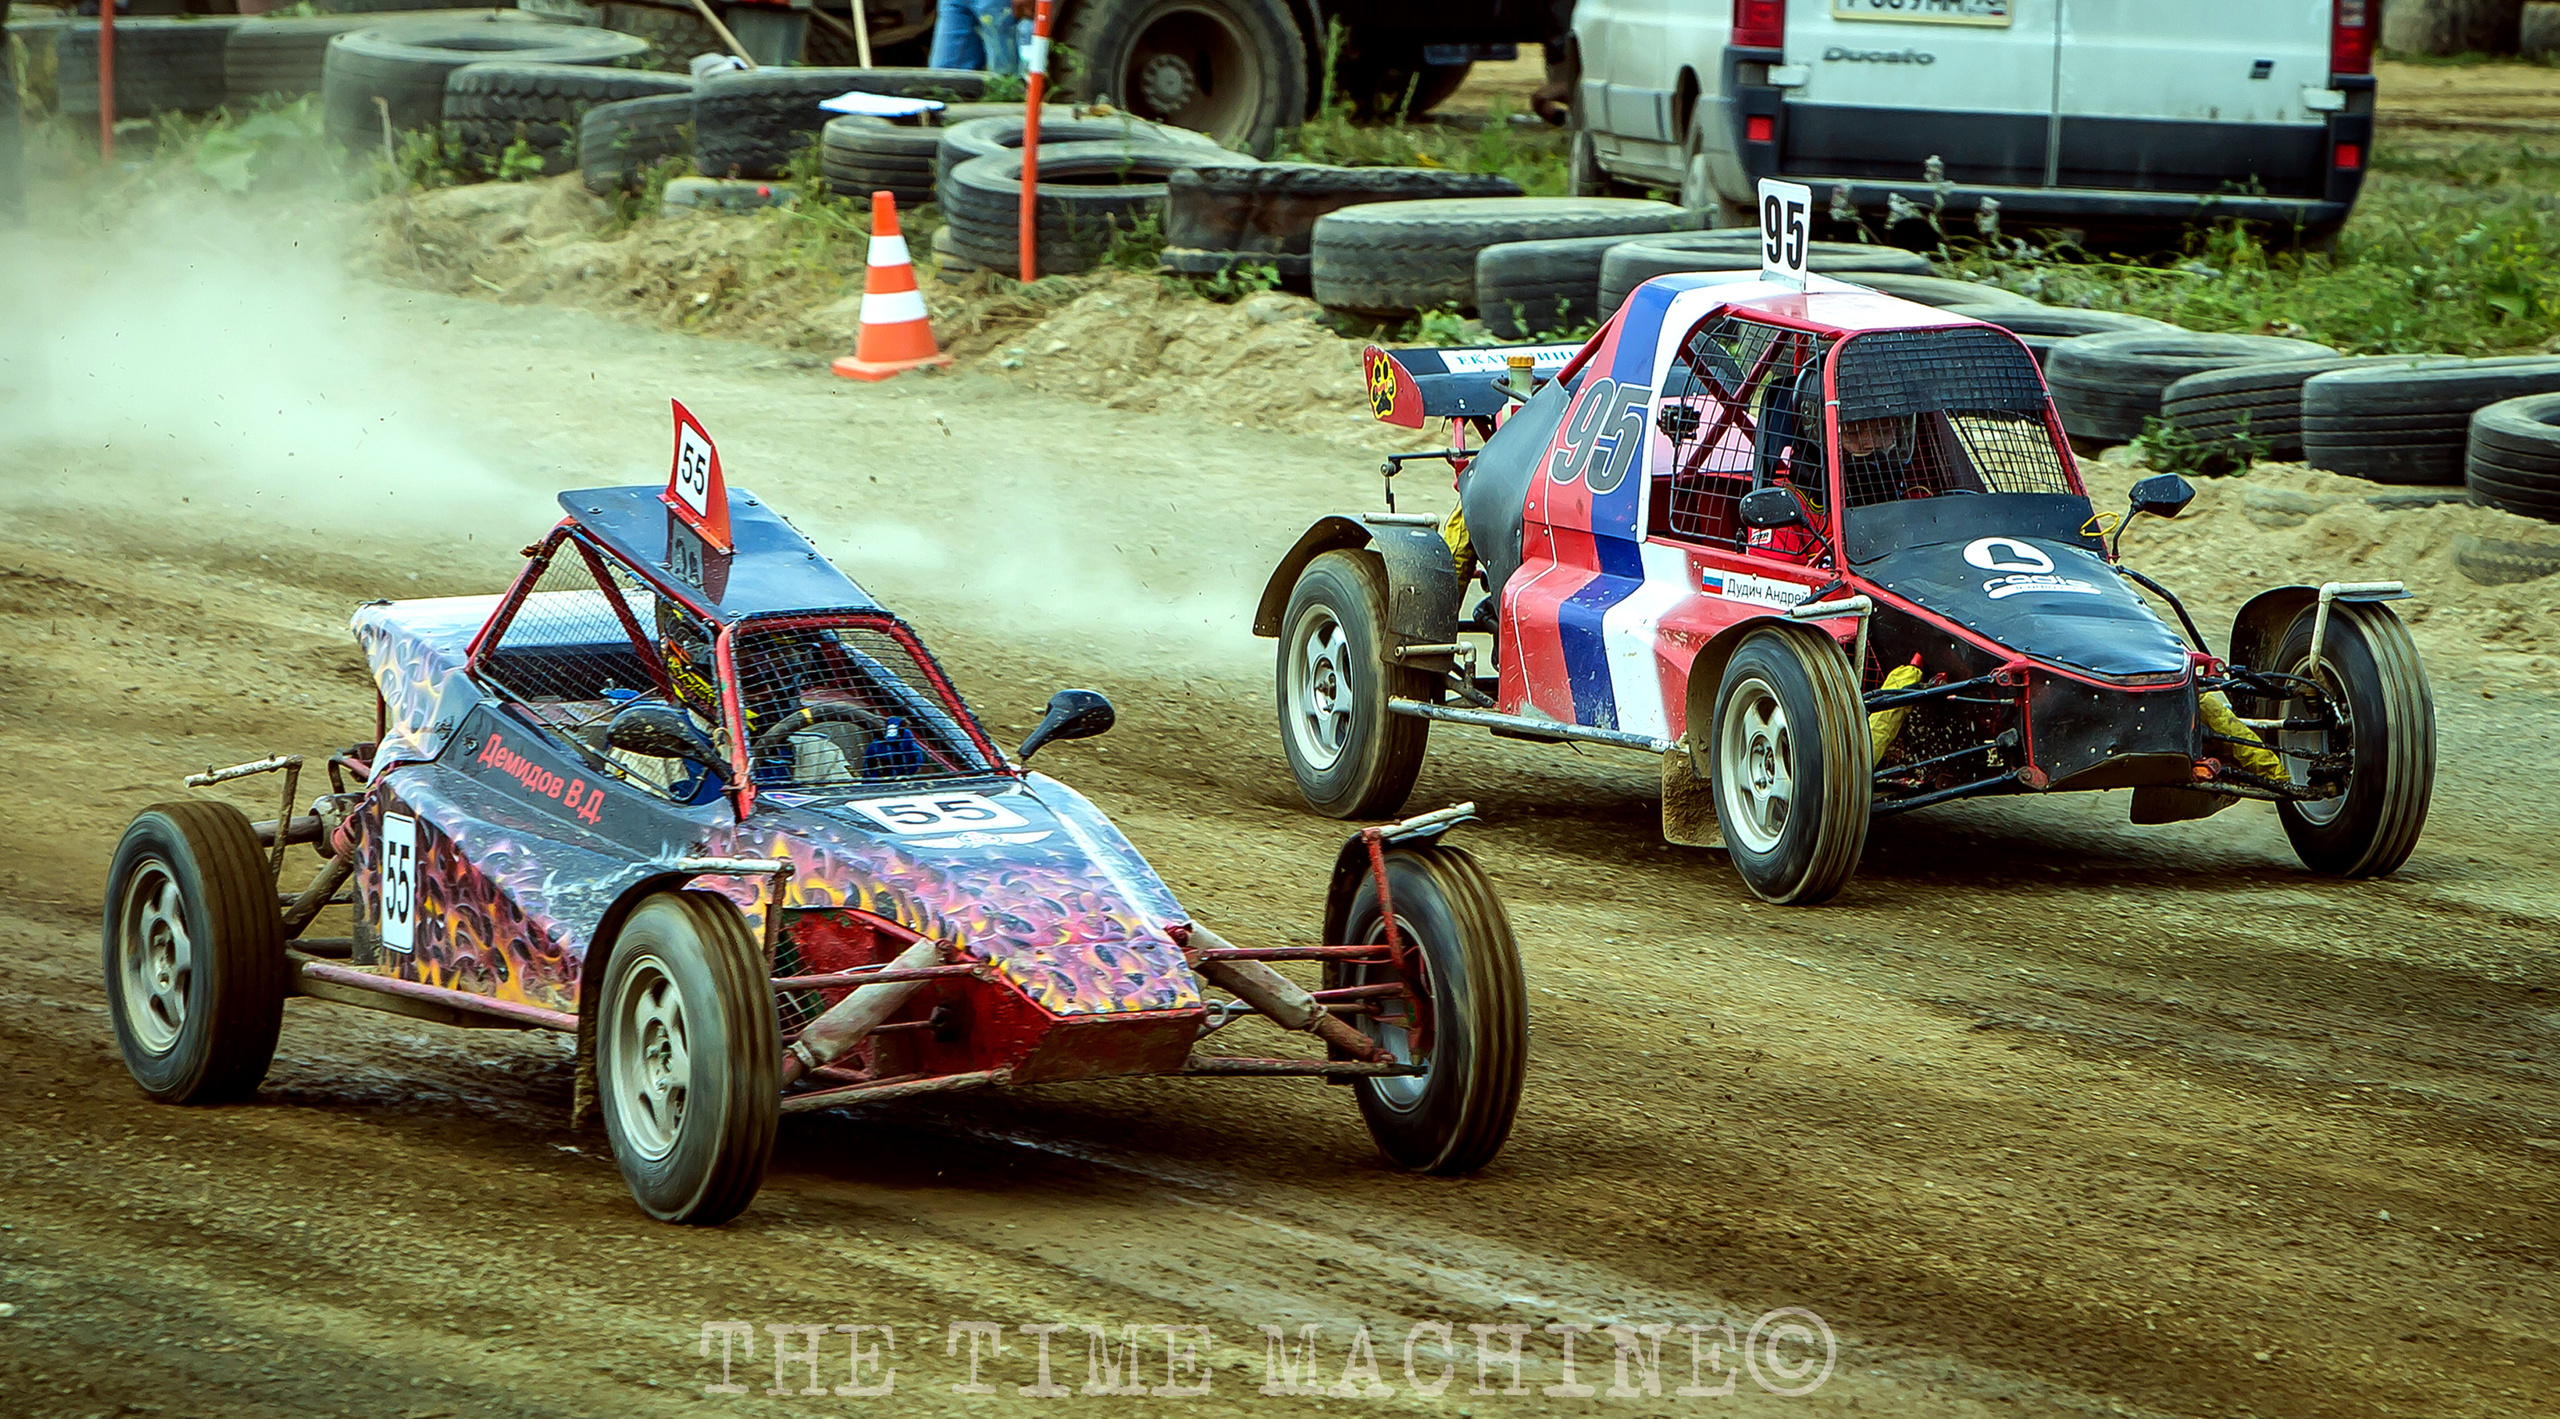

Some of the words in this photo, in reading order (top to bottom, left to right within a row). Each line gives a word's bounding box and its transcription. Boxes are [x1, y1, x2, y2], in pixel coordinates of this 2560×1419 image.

[1823, 47, 1935, 65] Ducato
[1764, 194, 1804, 270] 95
[1549, 376, 1653, 496] 95
[681, 442, 706, 496] 55
[1726, 578, 1763, 599] Дудич
[476, 733, 565, 799] Демидов
[563, 778, 606, 826] В.Д.
[877, 800, 998, 826] 55
[385, 840, 411, 924] 55
